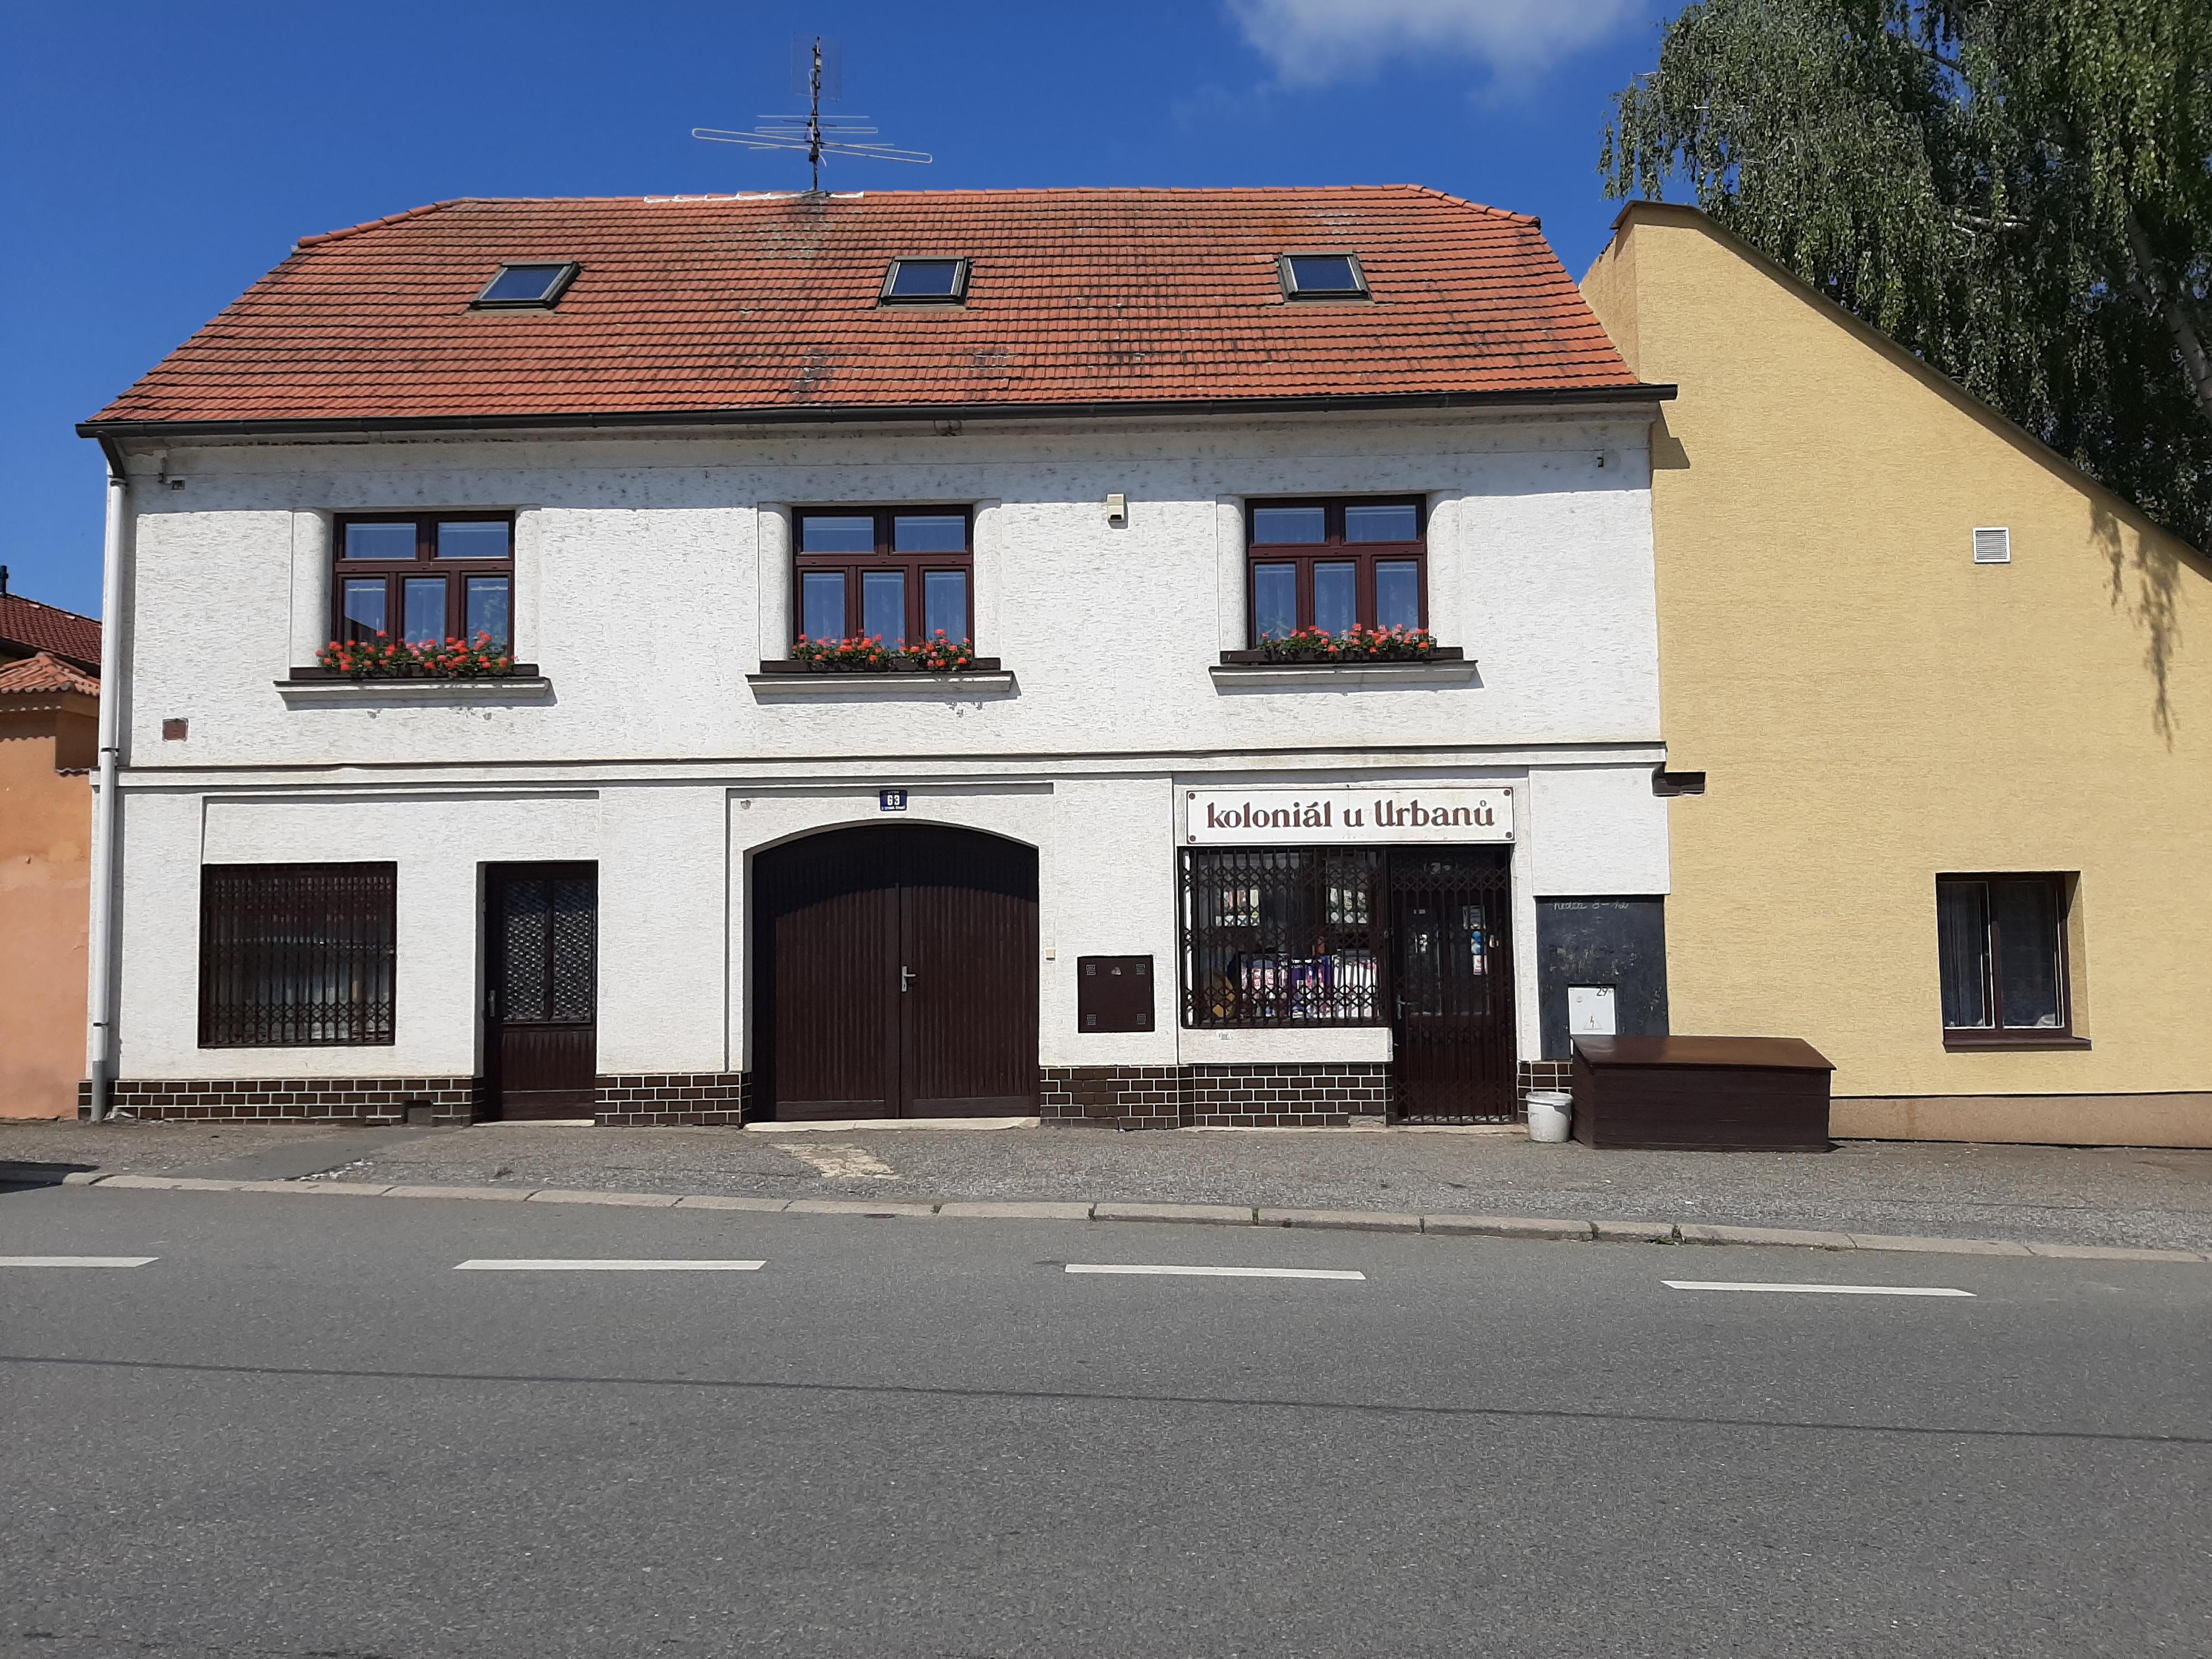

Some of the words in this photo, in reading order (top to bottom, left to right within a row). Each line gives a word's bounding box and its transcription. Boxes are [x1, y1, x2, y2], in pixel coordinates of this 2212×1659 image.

[887, 795, 900, 806] 63
[1207, 800, 1333, 828] koloniál
[1343, 808, 1365, 827] u
[1374, 799, 1495, 827] Urbanů
[1595, 987, 1608, 997] 29
